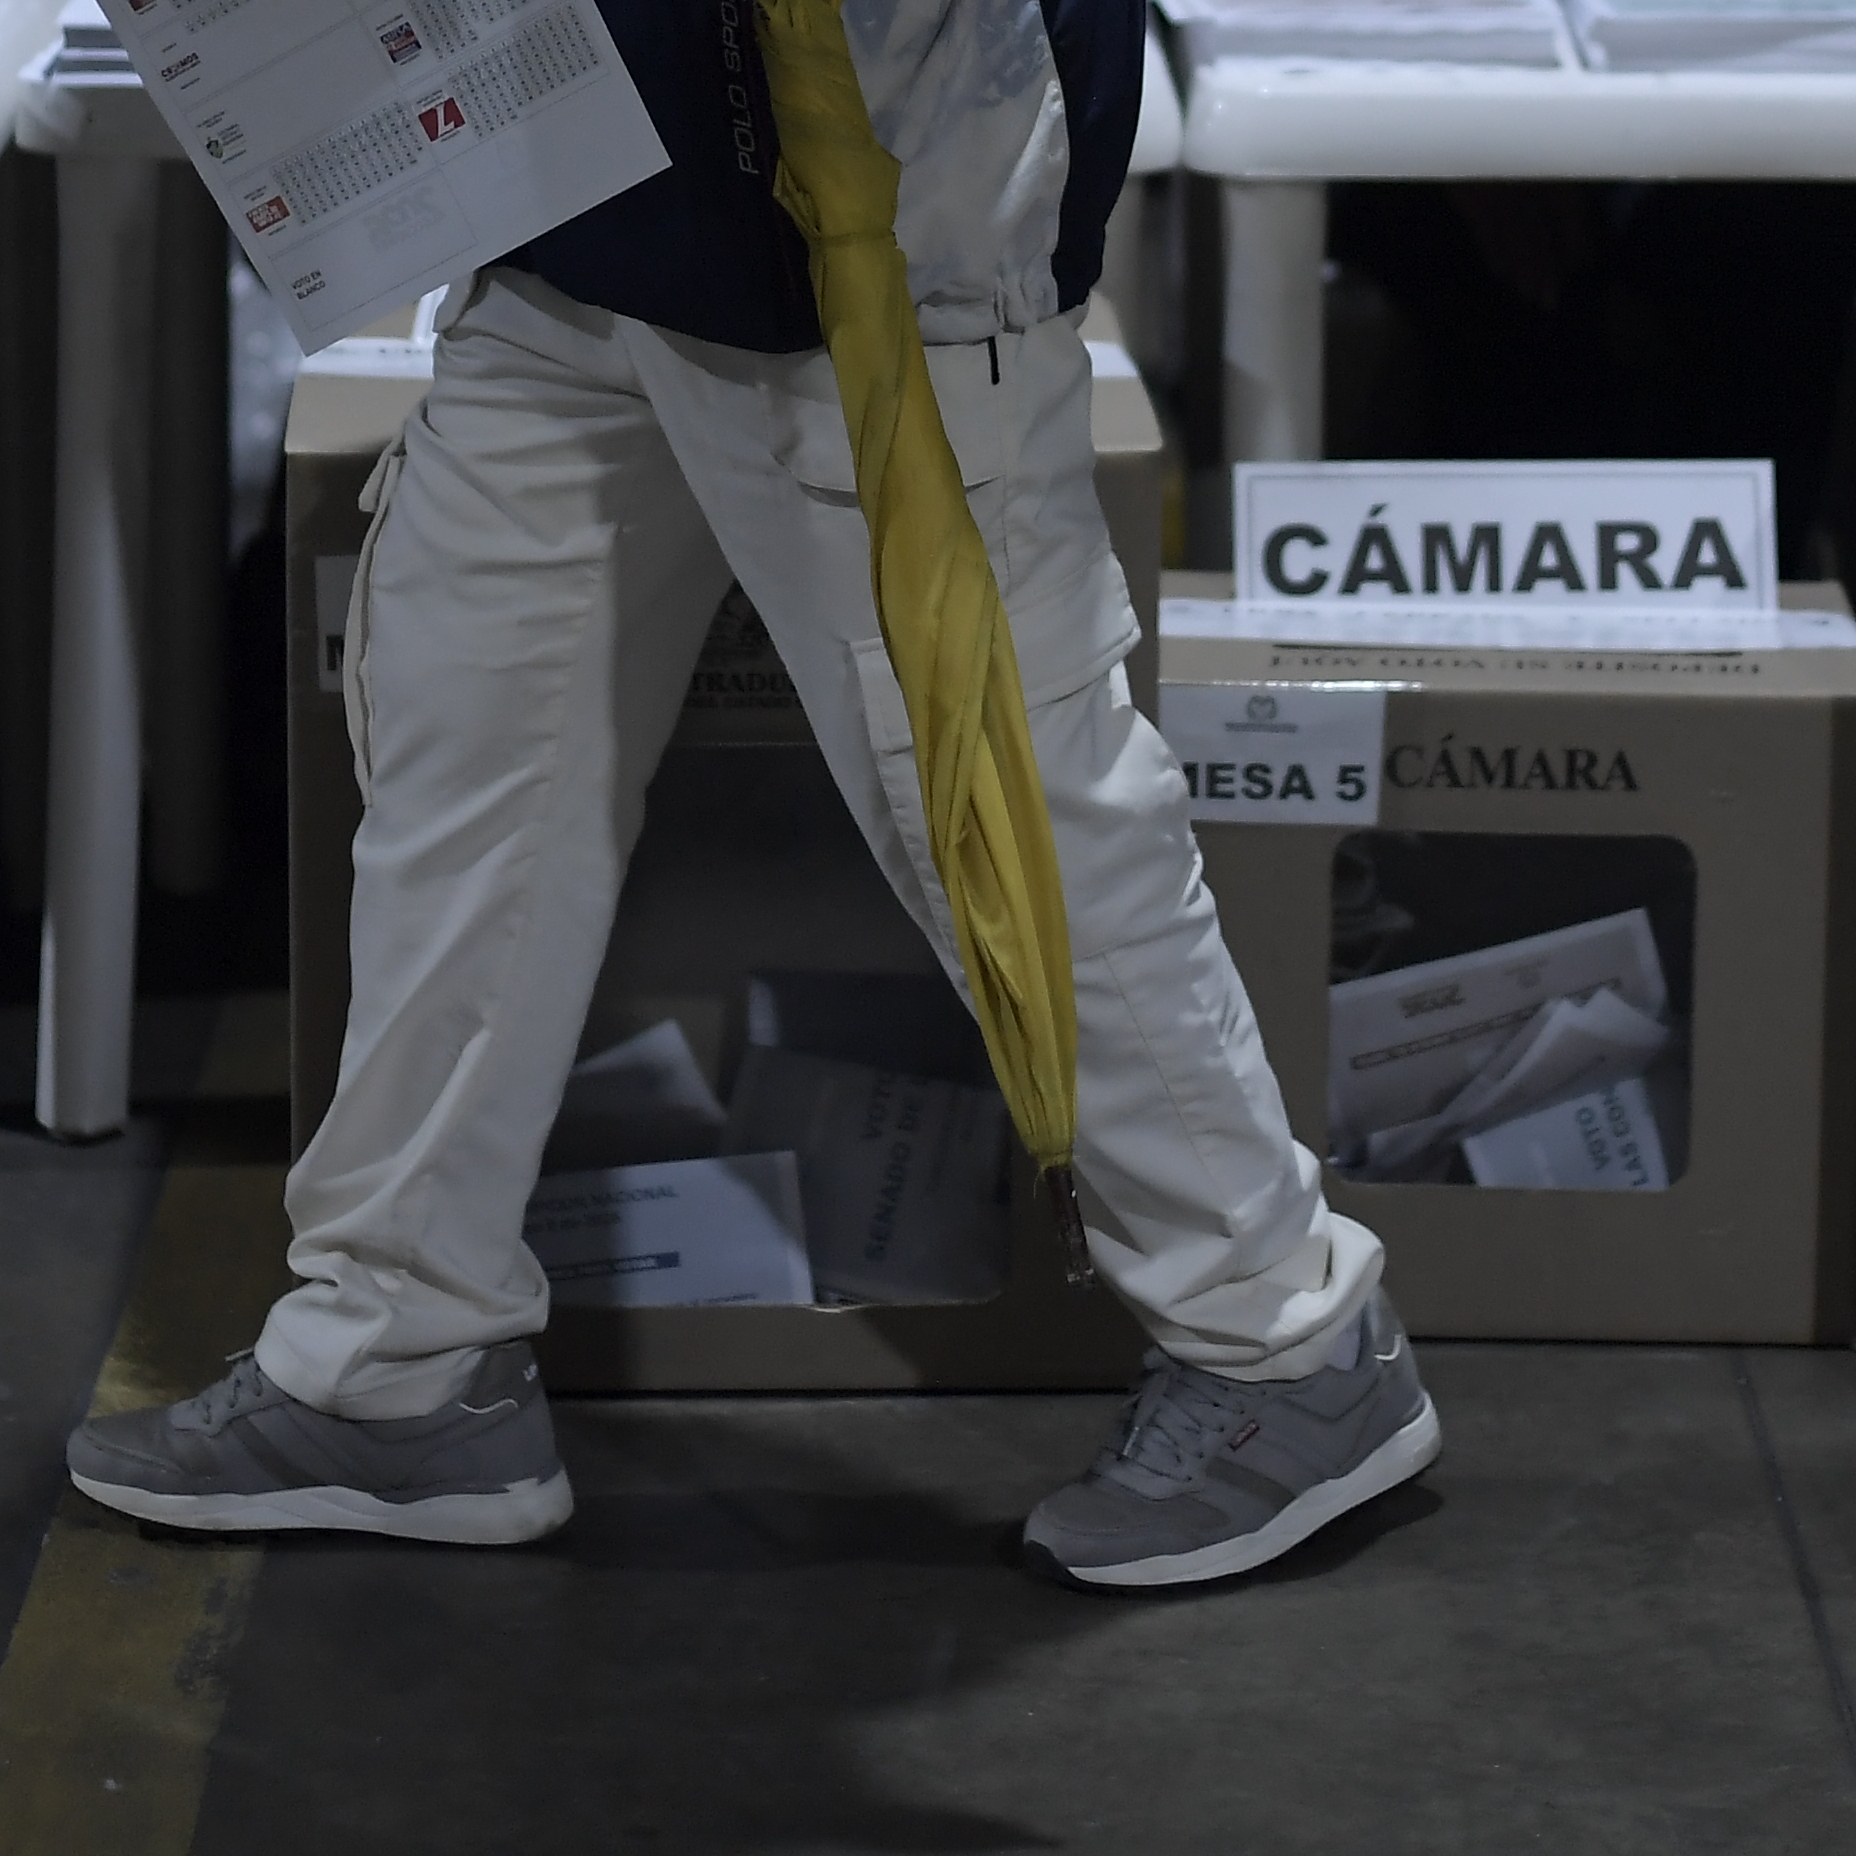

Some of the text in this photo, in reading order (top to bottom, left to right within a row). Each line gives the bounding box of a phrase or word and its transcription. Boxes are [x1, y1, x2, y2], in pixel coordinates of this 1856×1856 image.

[730, 85, 759, 175] POLO
[292, 270, 321, 289] VOTO EN
[297, 281, 325, 299] BLANCO
[1262, 504, 1748, 596] CÁMARA
[1335, 764, 1368, 802] 5
[1385, 733, 1640, 792] CÁMARA
